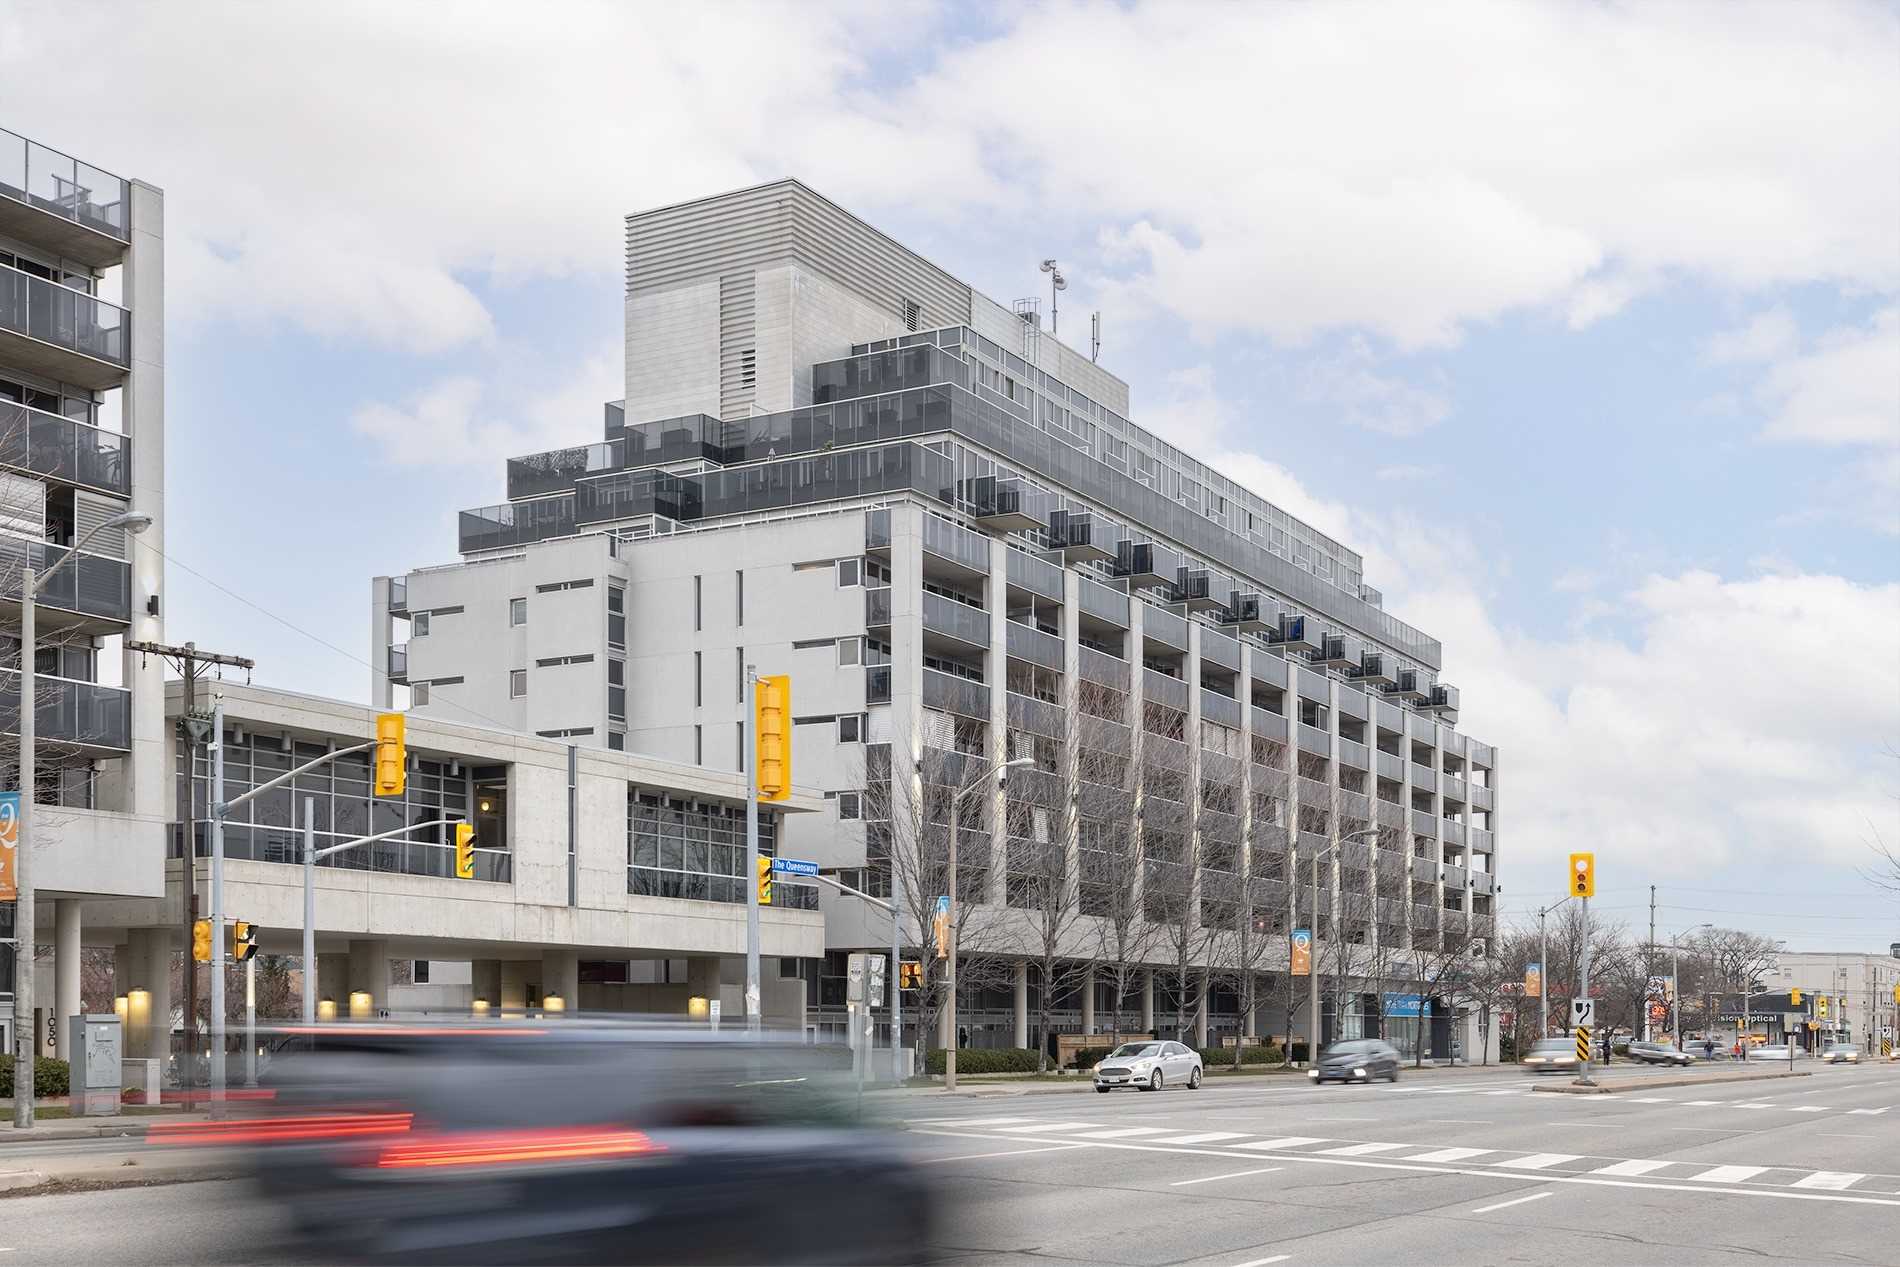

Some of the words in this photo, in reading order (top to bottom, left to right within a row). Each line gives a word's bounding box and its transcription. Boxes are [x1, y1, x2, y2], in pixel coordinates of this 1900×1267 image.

[774, 859, 784, 869] The
[786, 861, 817, 876] Queensway
[47, 1007, 56, 1047] 1050
